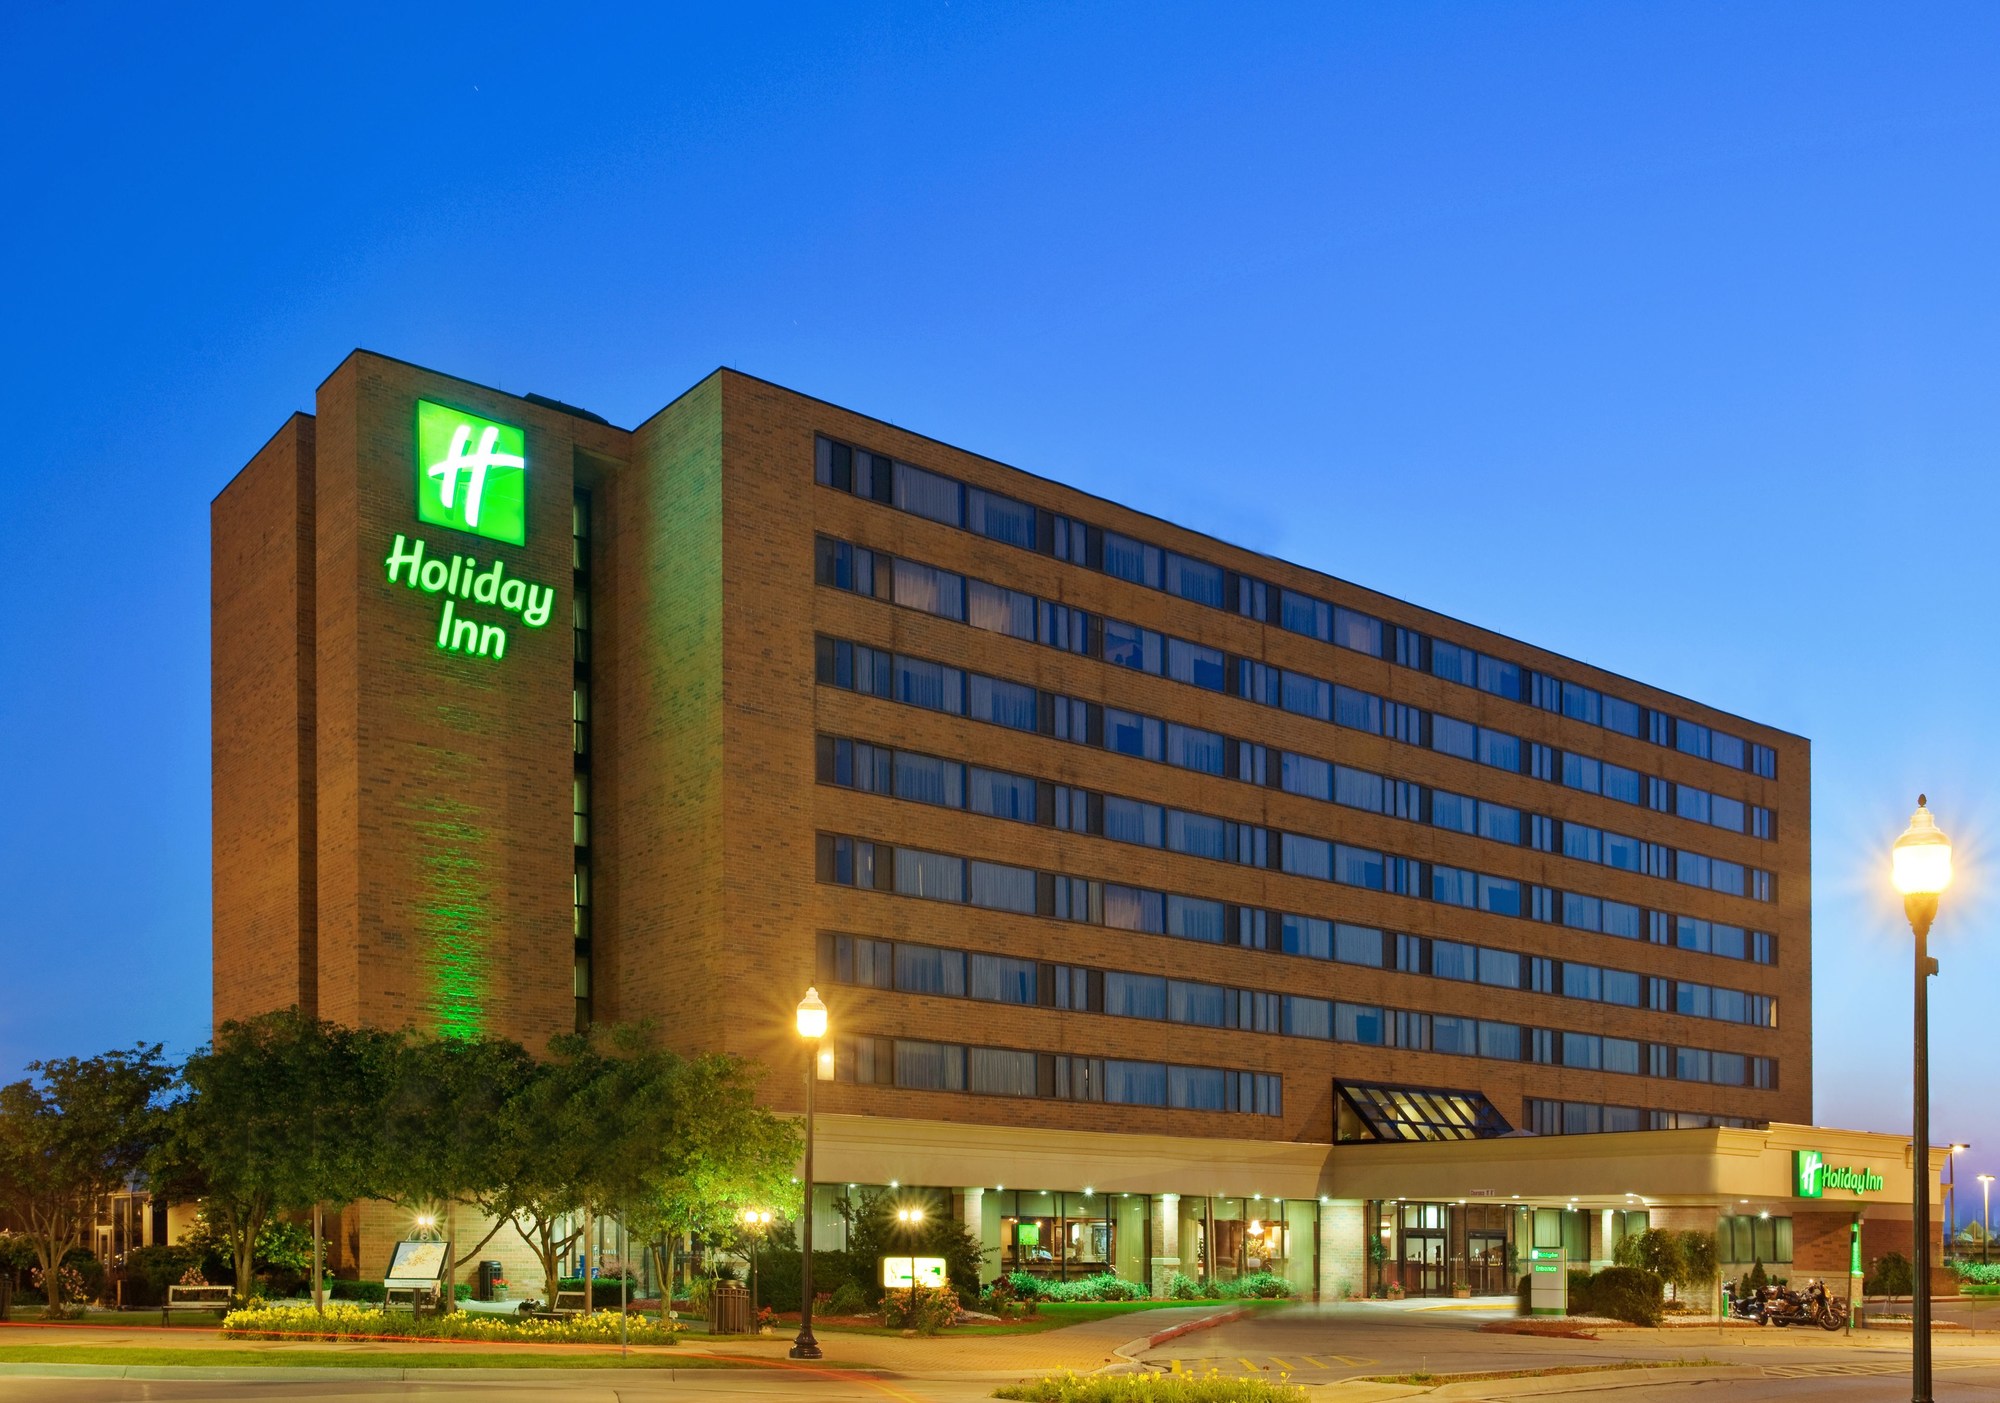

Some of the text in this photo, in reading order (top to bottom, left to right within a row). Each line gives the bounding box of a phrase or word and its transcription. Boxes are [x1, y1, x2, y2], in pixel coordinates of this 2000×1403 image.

[385, 534, 554, 627] Holiday
[437, 600, 506, 661] Inn
[1822, 1164, 1883, 1195] Holiday Inn
[1535, 1264, 1557, 1272] Entrance
